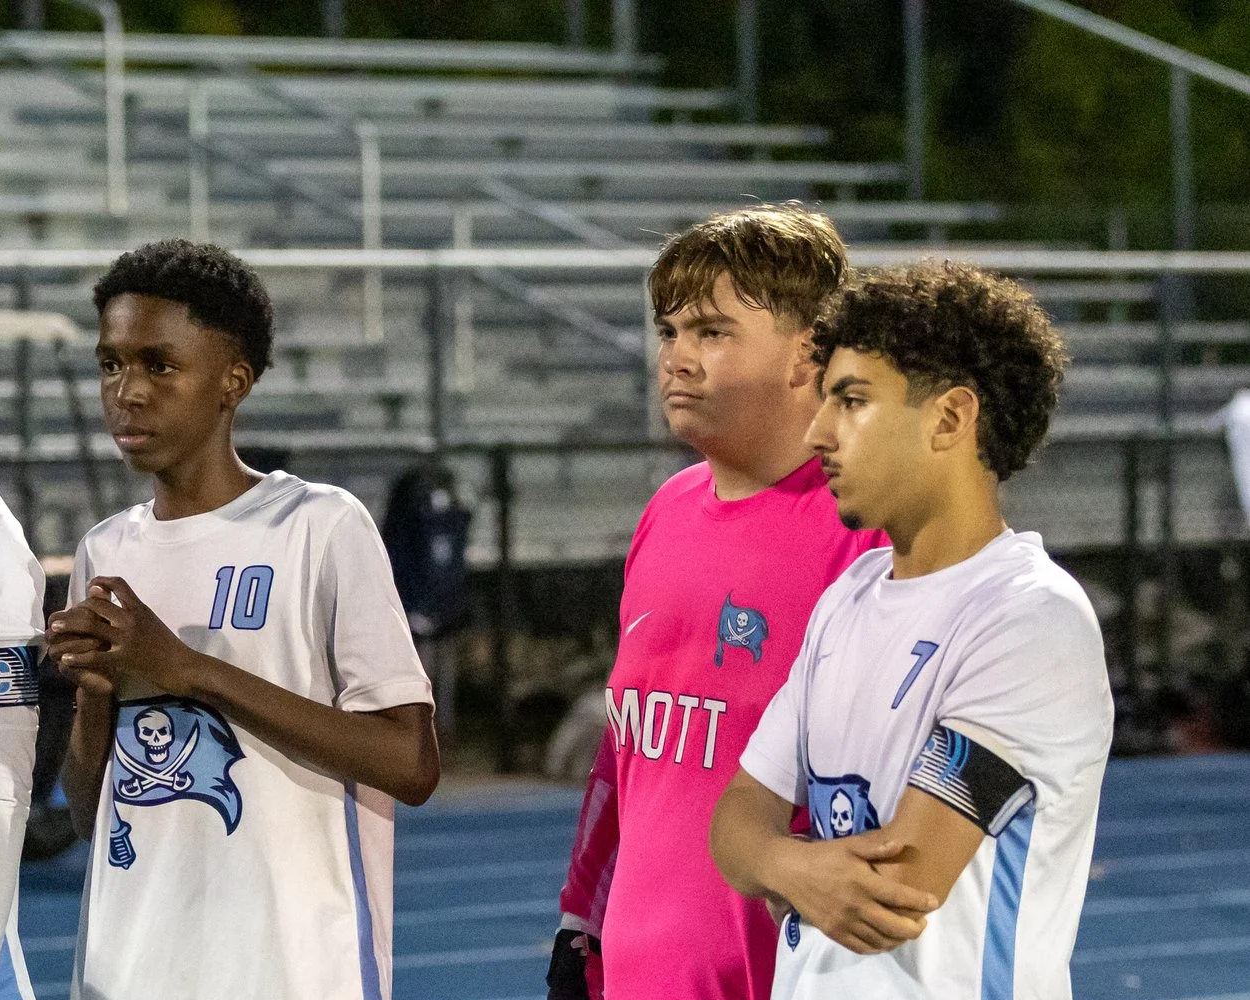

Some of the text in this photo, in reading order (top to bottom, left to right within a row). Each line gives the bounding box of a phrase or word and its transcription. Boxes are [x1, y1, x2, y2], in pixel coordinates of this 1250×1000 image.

[209, 565, 274, 630] 10
[891, 640, 939, 709] 7
[605, 687, 727, 769] MOTT
